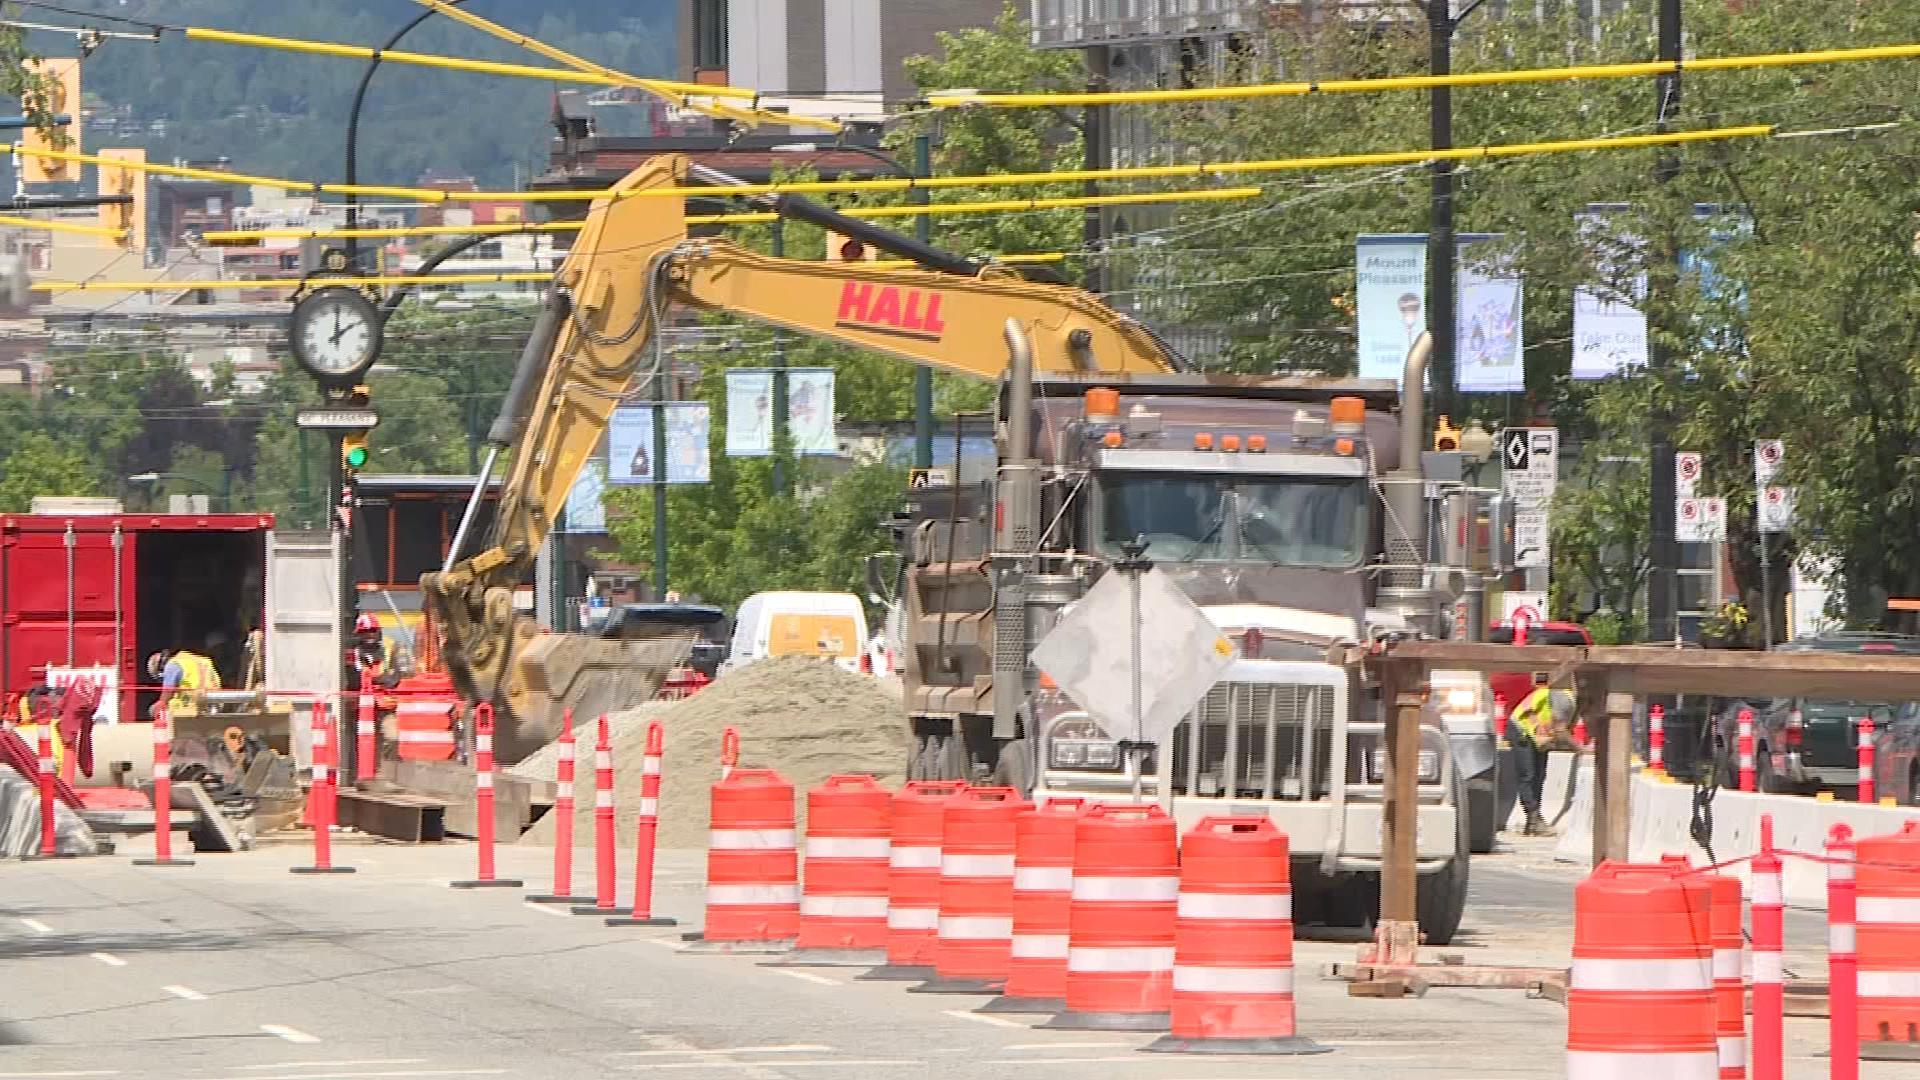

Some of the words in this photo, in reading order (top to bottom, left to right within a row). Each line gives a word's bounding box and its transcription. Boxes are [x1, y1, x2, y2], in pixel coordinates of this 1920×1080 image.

[1366, 256, 1417, 269] Mount
[1359, 272, 1423, 285] Pleasant
[837, 279, 944, 333] HALL
